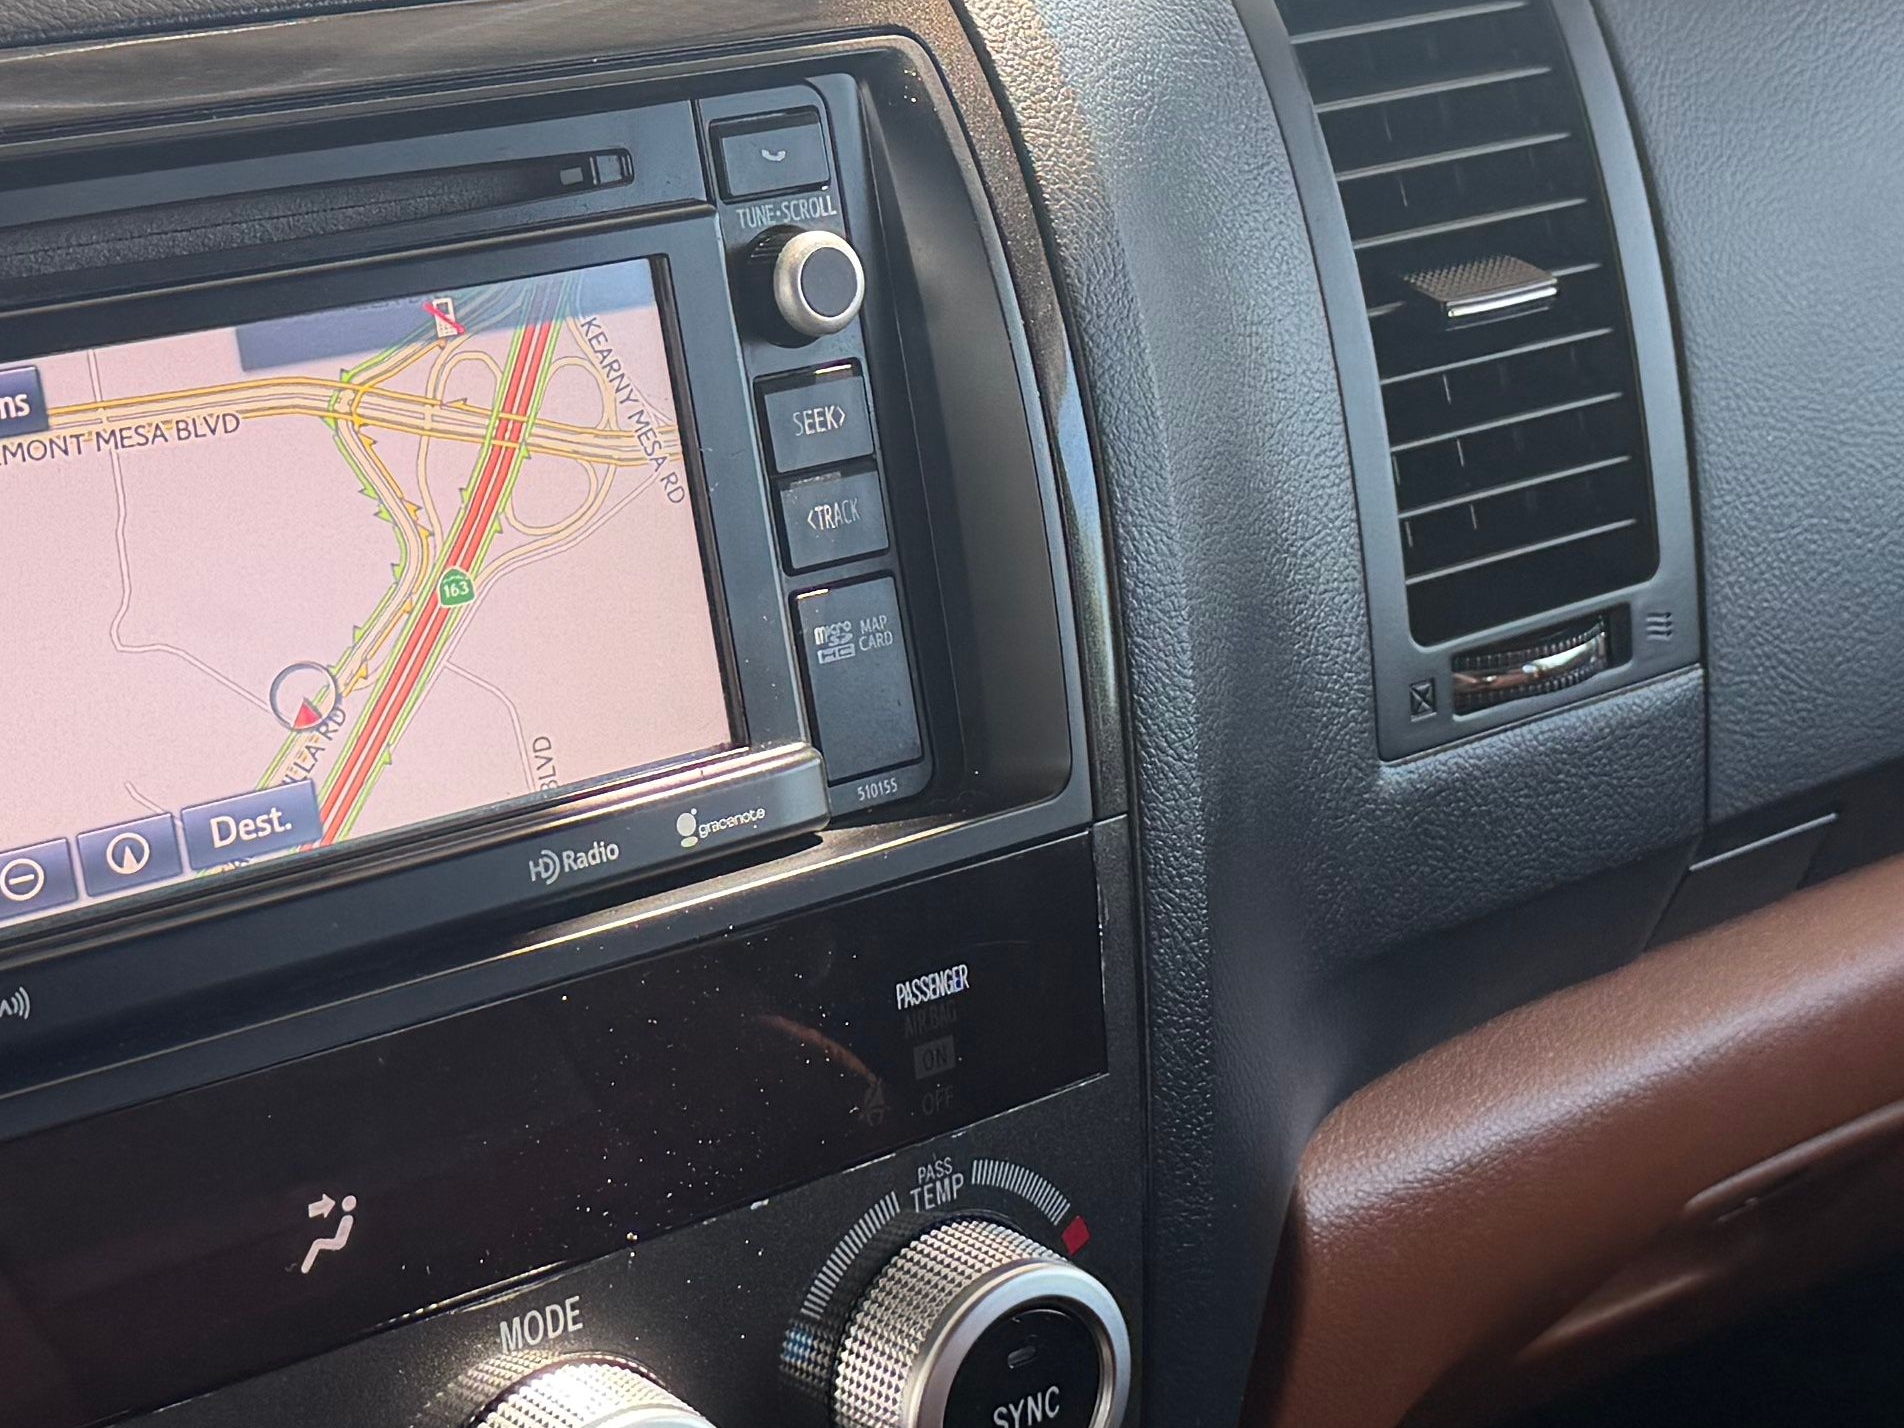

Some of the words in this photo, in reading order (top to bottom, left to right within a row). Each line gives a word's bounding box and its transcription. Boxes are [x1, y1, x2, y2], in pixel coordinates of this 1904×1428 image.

[581, 315, 640, 408] KEARNY
[627, 410, 668, 472] MESA
[658, 471, 686, 507] RD
[95, 422, 167, 452] MESA
[175, 412, 241, 441] BLVD
[443, 581, 469, 598] 163
[859, 631, 894, 651] CARD
[860, 615, 888, 634] MAP
[317, 706, 347, 741] RD
[857, 777, 898, 801] 510155
[209, 807, 293, 849] Dest.
[698, 804, 766, 839] gracenote
[562, 840, 620, 874] Radio
[896, 963, 969, 1010] PASSENGER
[922, 1045, 947, 1071] ON
[921, 1084, 955, 1117] OFF
[917, 1155, 953, 1182] PASS
[910, 1173, 965, 1213] TEMP
[498, 1295, 584, 1353] MODE
